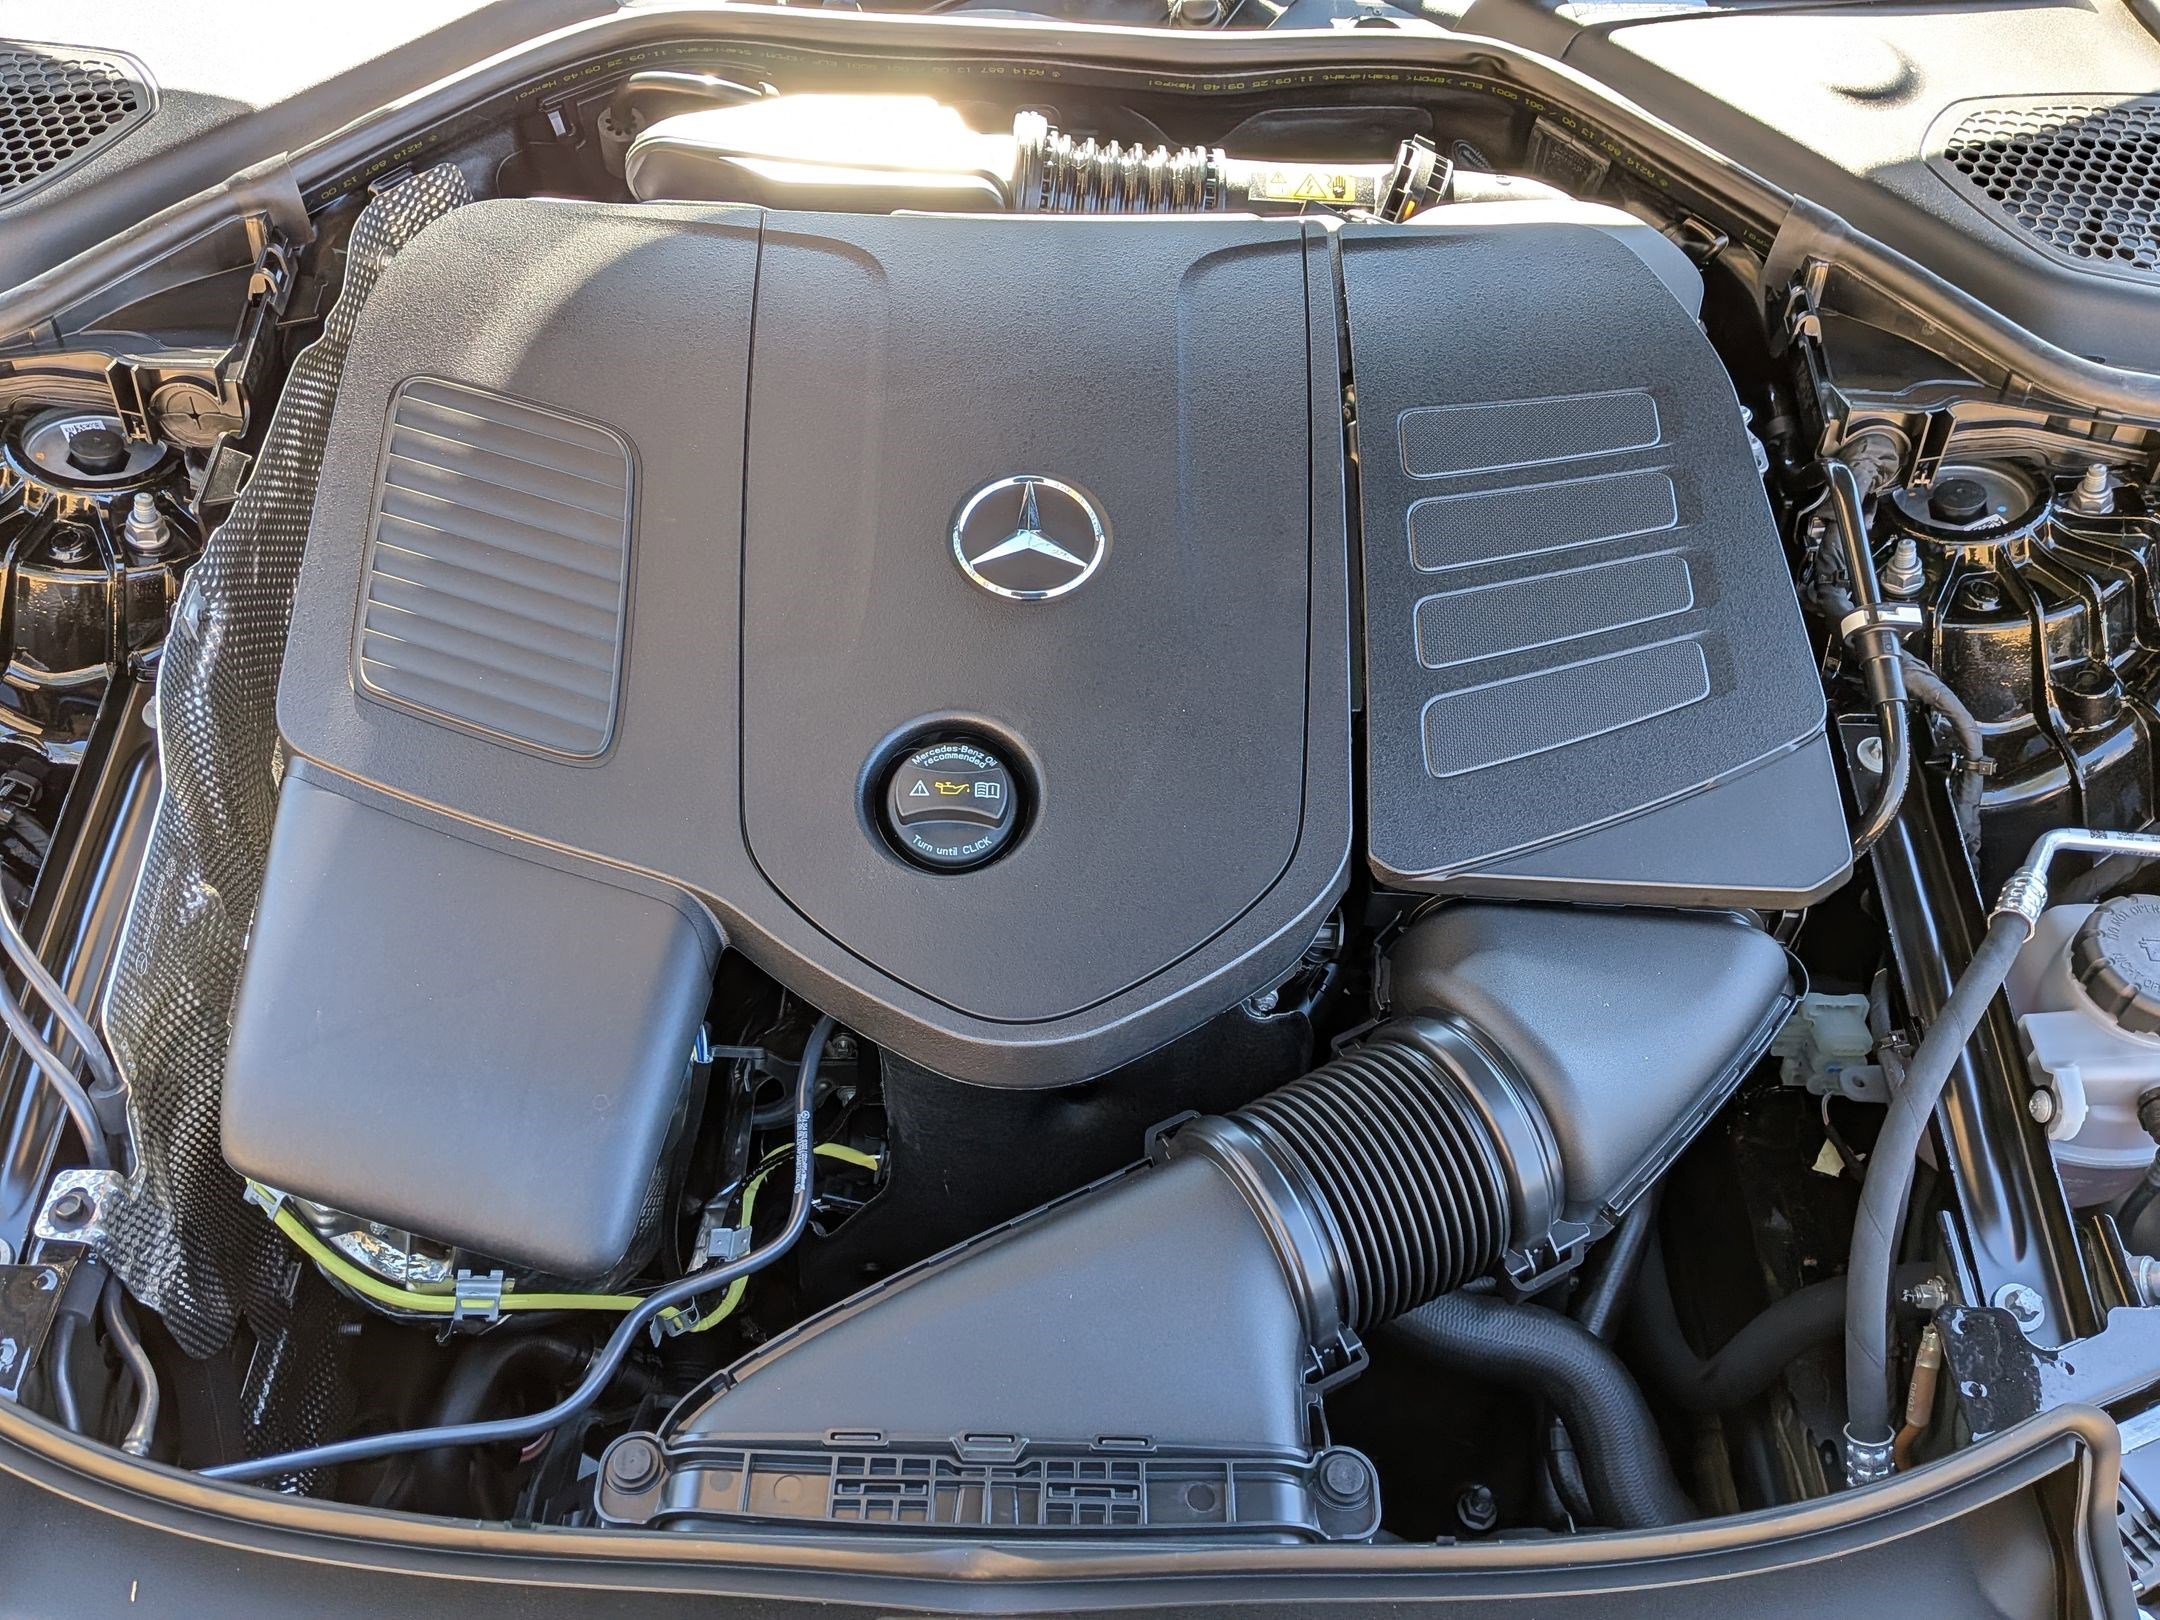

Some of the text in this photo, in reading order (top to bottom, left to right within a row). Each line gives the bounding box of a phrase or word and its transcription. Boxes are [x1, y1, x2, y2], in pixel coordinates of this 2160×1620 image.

[911, 744, 998, 768] Mercedes-Benz Oil
[923, 752, 987, 769] recommended
[912, 834, 993, 856] Turn until CLICK
